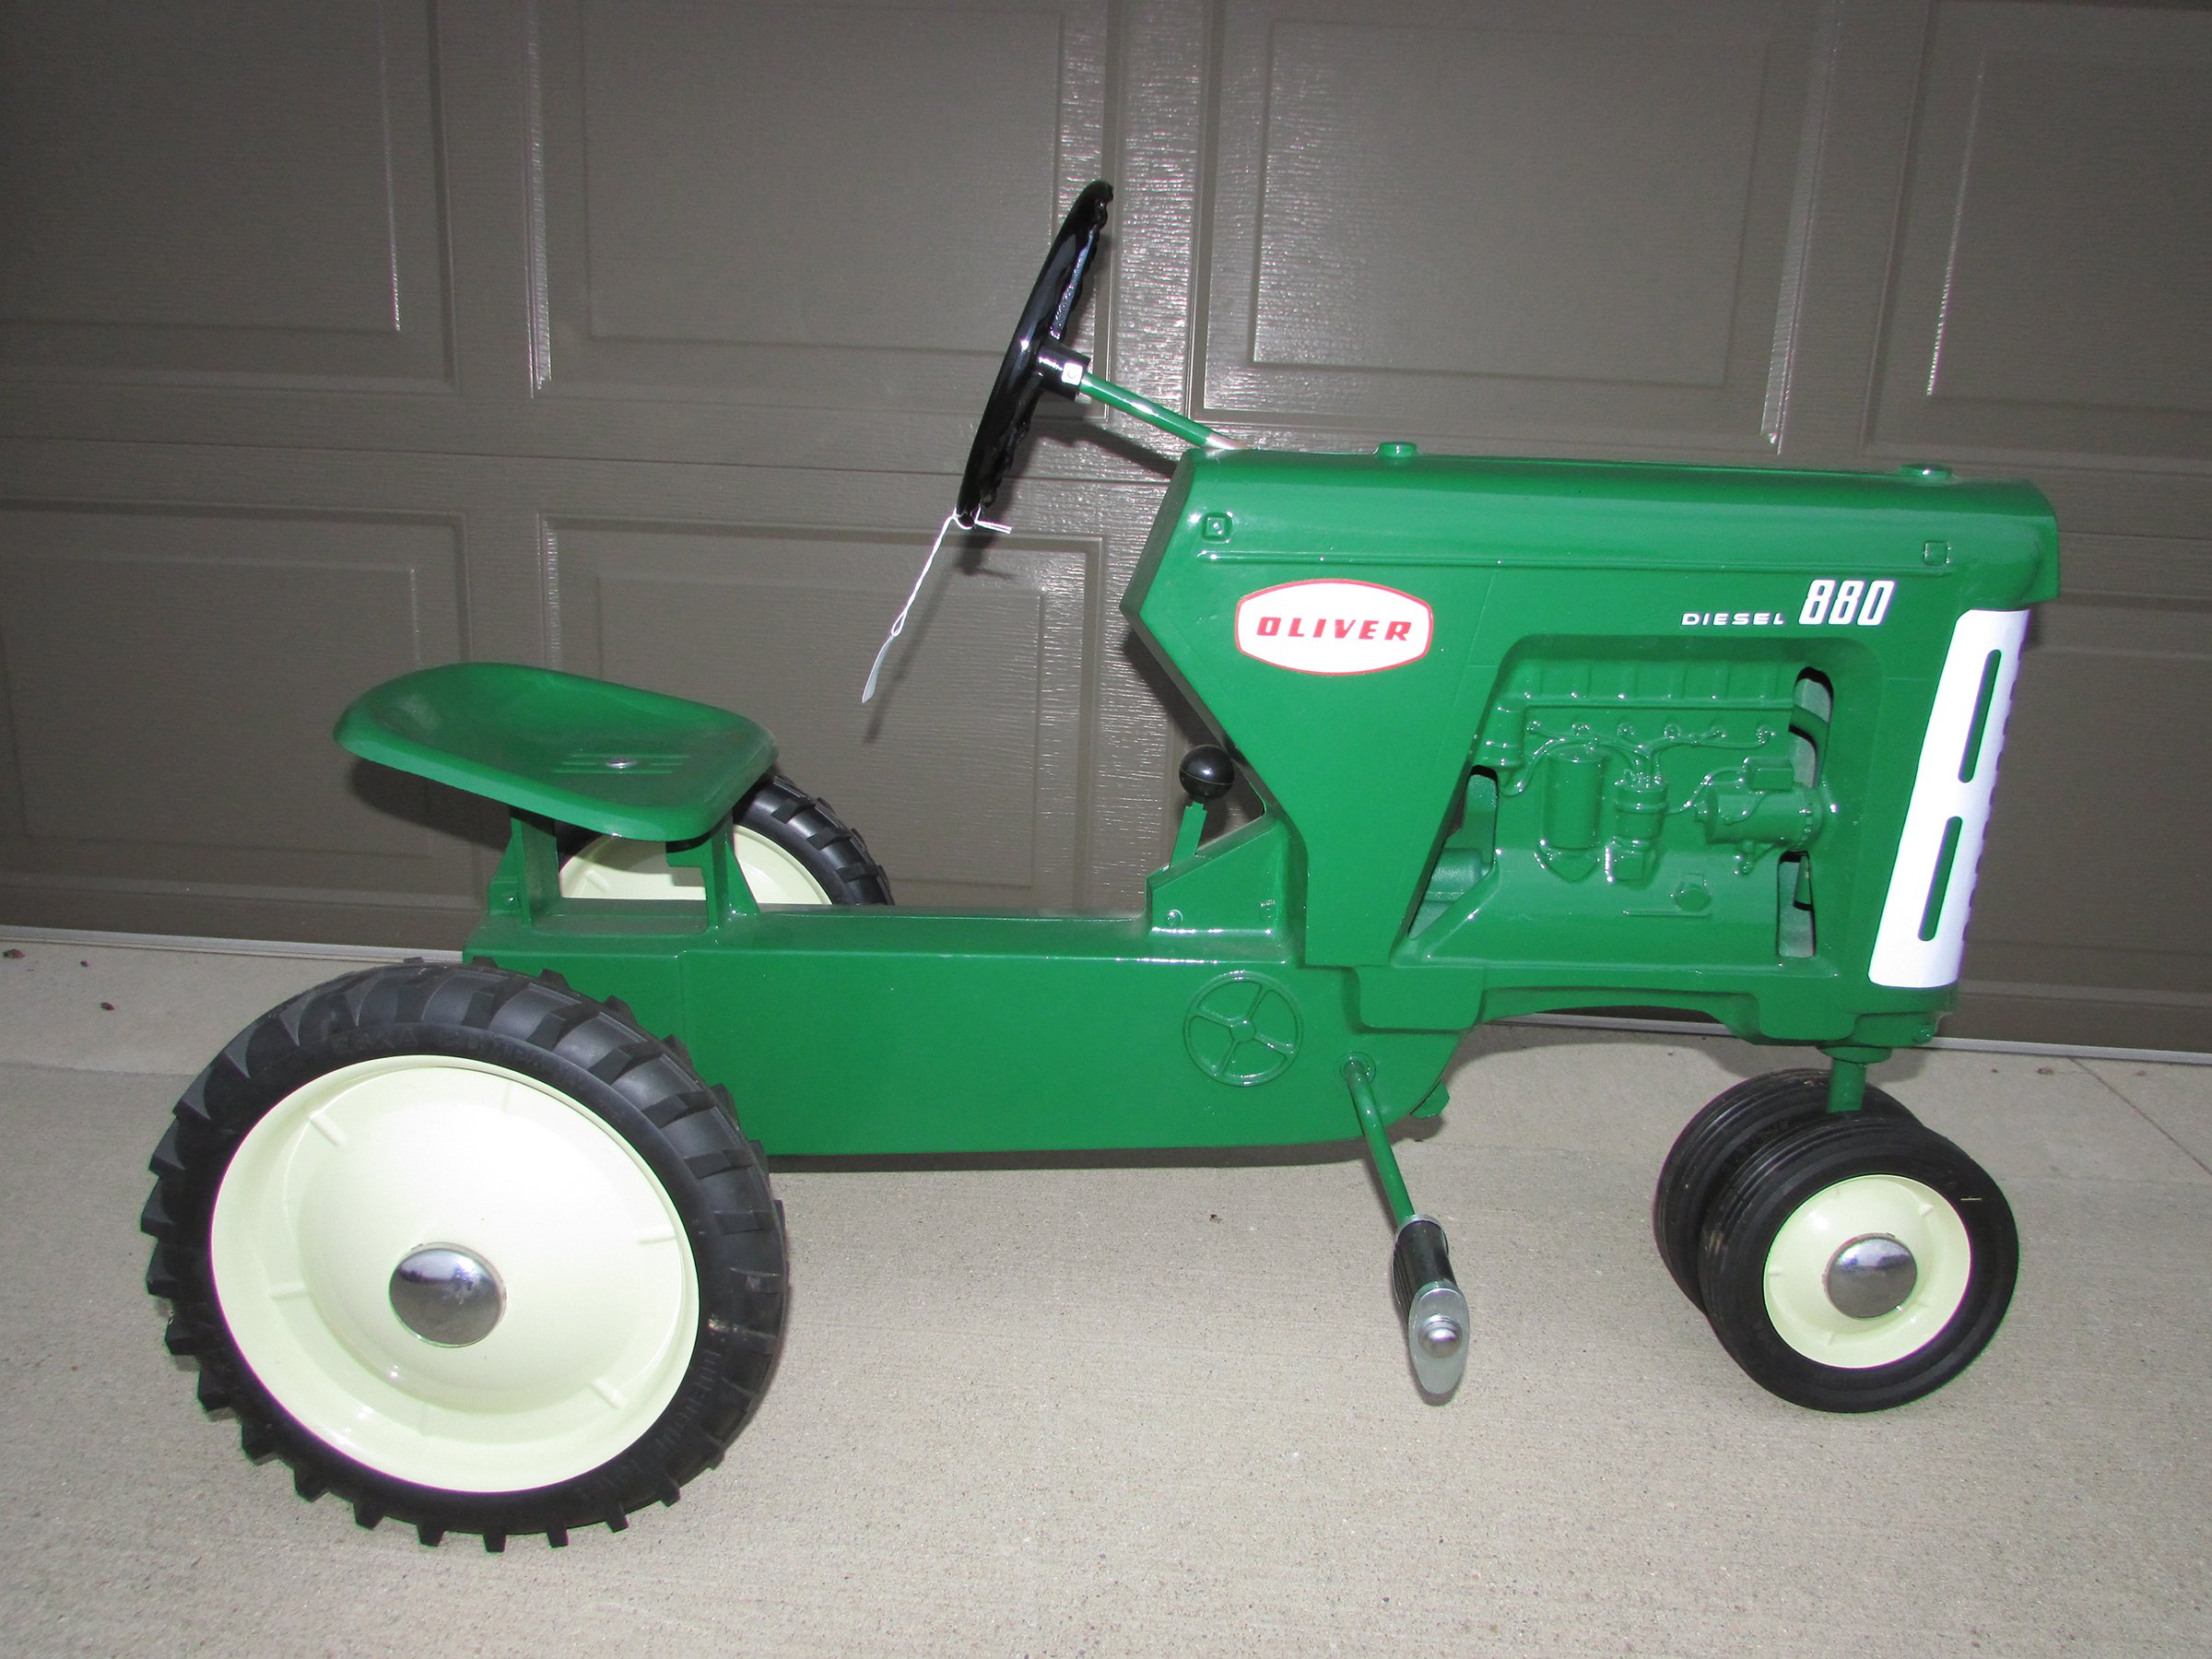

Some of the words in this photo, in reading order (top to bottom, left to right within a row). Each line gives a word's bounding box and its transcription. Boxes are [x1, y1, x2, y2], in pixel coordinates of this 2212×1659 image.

[1682, 612, 1784, 626] DIESEL
[1798, 579, 1895, 626] 880
[1256, 617, 1412, 641] OLIVER
